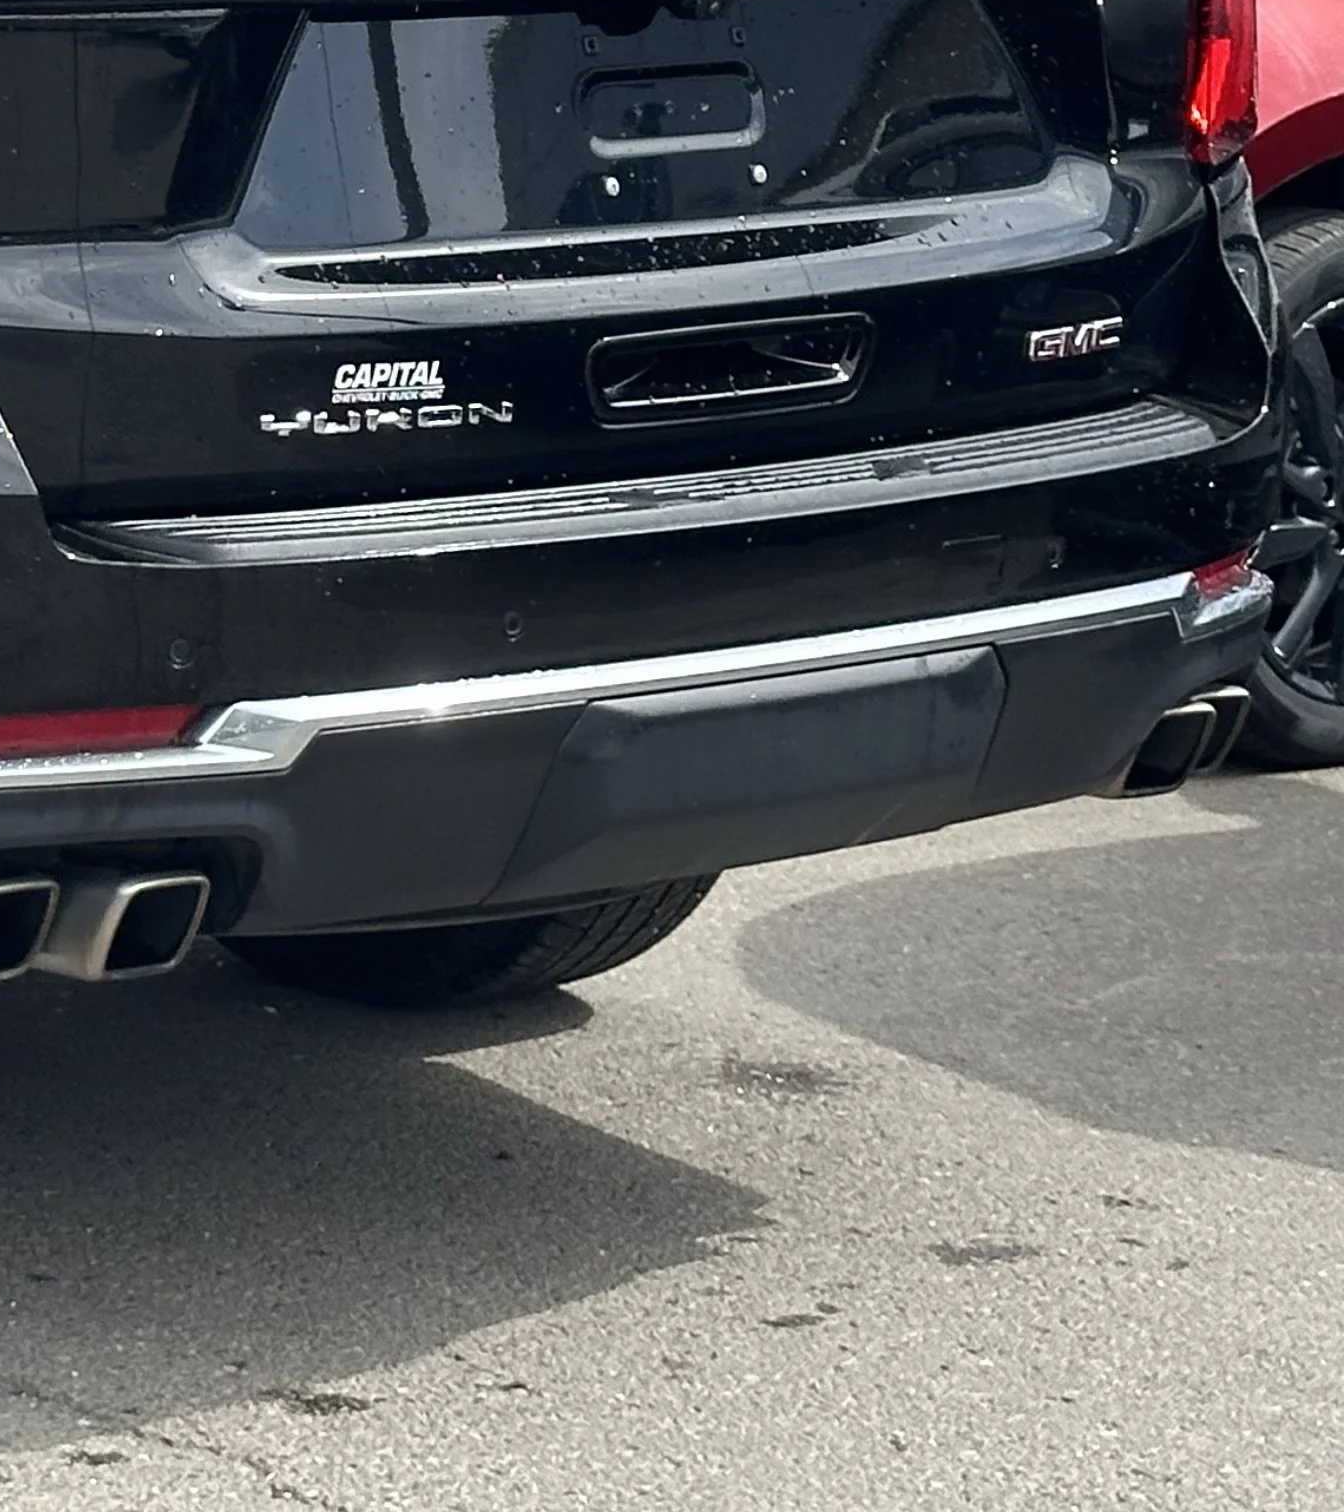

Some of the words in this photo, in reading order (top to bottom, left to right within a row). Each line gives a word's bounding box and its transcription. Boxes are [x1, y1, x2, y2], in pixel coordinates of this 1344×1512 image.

[1026, 316, 1123, 361] GMC
[334, 361, 444, 388] CAPITAL
[260, 401, 513, 437] YUKON
